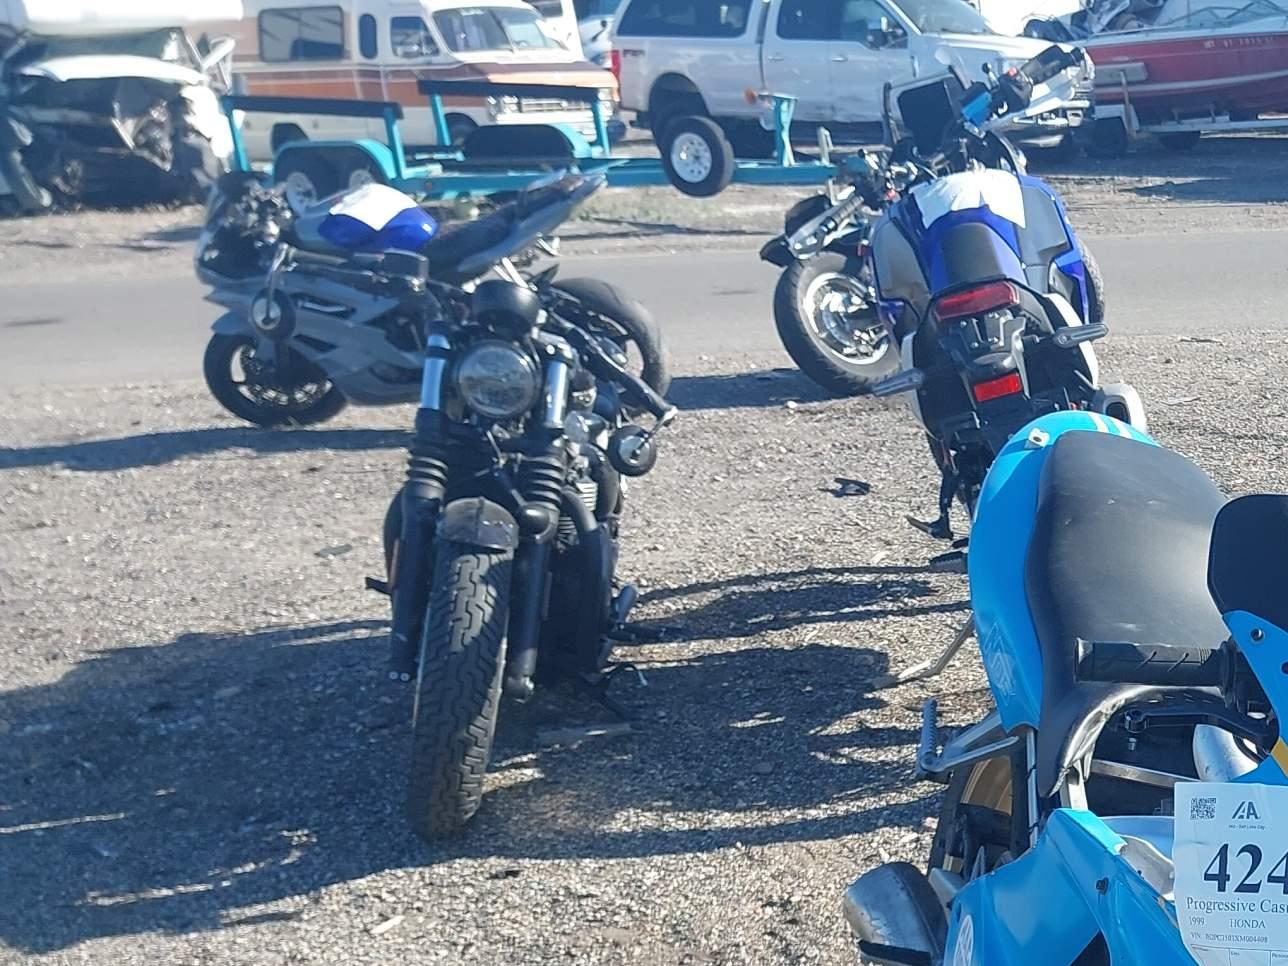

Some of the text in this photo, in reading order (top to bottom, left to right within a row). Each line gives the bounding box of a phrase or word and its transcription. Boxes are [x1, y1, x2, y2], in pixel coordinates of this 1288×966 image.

[1186, 897, 1256, 914] Progressive
[1189, 916, 1205, 926] 1999
[1230, 918, 1266, 929] HONDA
